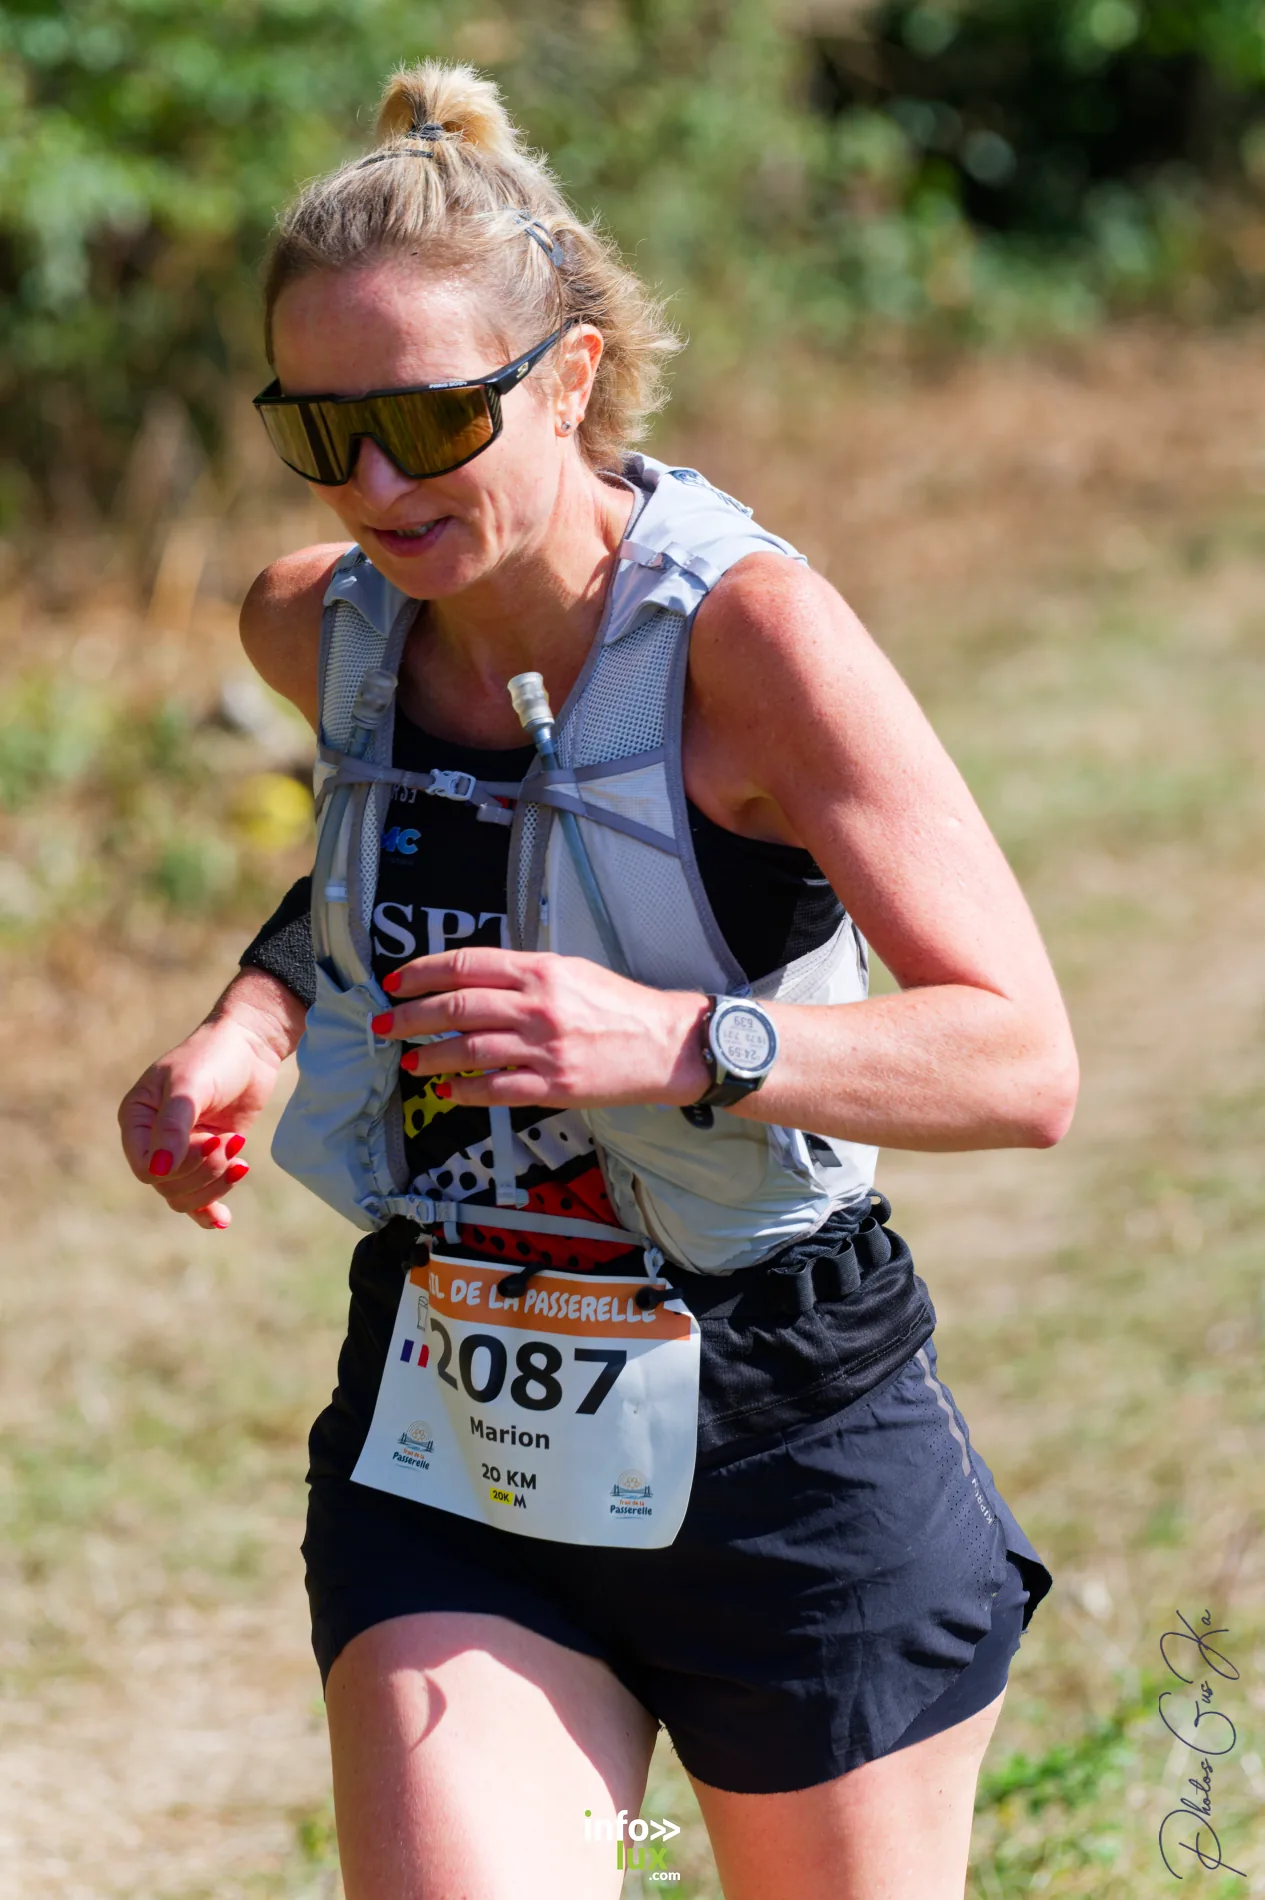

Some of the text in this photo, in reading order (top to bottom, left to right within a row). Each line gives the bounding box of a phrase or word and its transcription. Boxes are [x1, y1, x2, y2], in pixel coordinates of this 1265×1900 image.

[450, 1278, 483, 1306] DE
[524, 1288, 656, 1323] PASSERELLE
[430, 1317, 627, 1415] 2087
[470, 1415, 550, 1450] Marion
[392, 1451, 430, 1470] Passerelle
[481, 1463, 536, 1490] 20 KM
[513, 1494, 527, 1509] M
[610, 1504, 653, 1516] Passerelle
